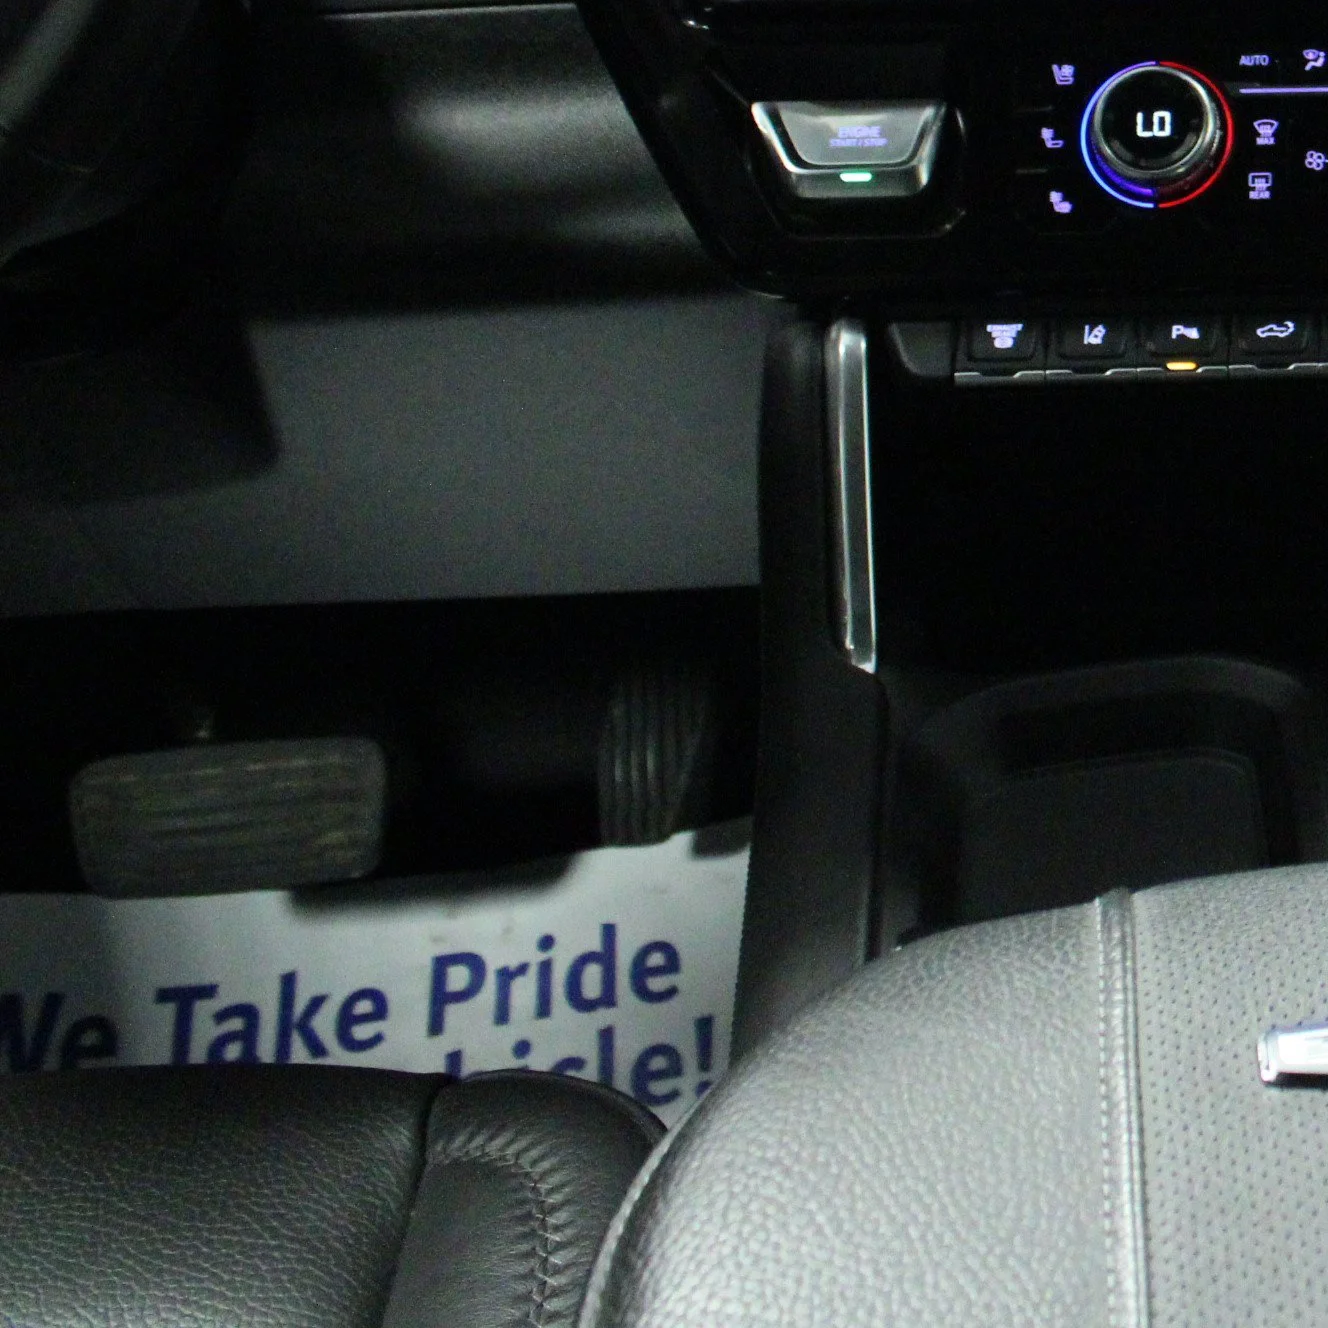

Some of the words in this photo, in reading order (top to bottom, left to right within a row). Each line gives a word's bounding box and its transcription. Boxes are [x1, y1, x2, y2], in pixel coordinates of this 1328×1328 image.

[1239, 54, 1270, 67] AUTO
[1135, 110, 1172, 138] LO
[153, 971, 390, 1067] Take
[426, 922, 682, 1038] Pride
